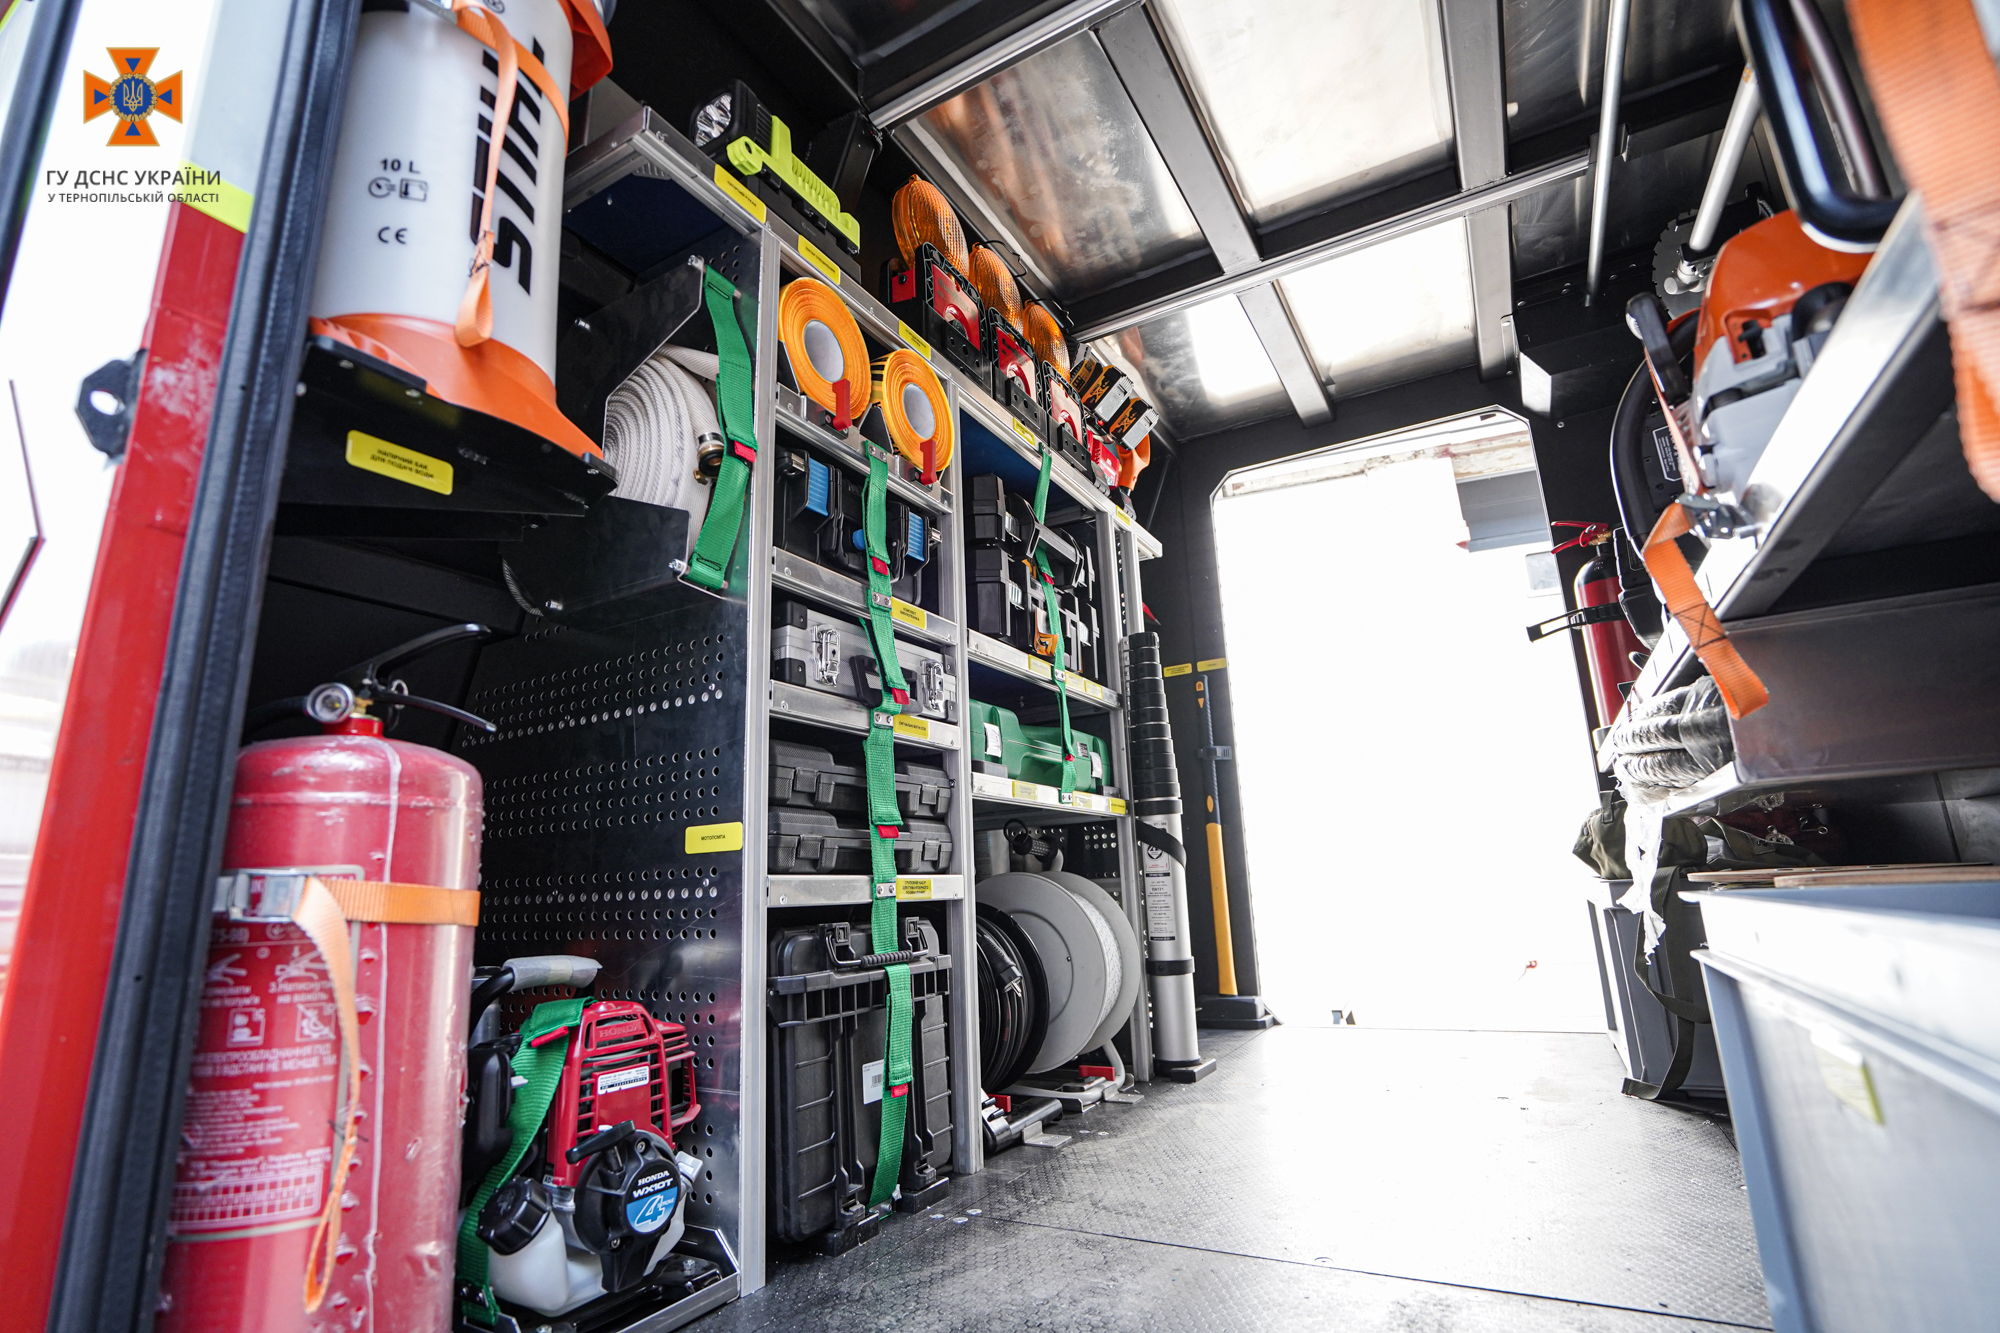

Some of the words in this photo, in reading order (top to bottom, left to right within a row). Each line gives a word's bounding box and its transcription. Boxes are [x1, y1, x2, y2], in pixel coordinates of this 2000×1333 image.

[380, 158, 402, 171] 10
[409, 160, 421, 174] L
[600, 1023, 643, 1038] HONDA
[637, 1170, 670, 1187] HONDA
[632, 1177, 674, 1198] WX10T
[634, 1194, 666, 1227] 4
